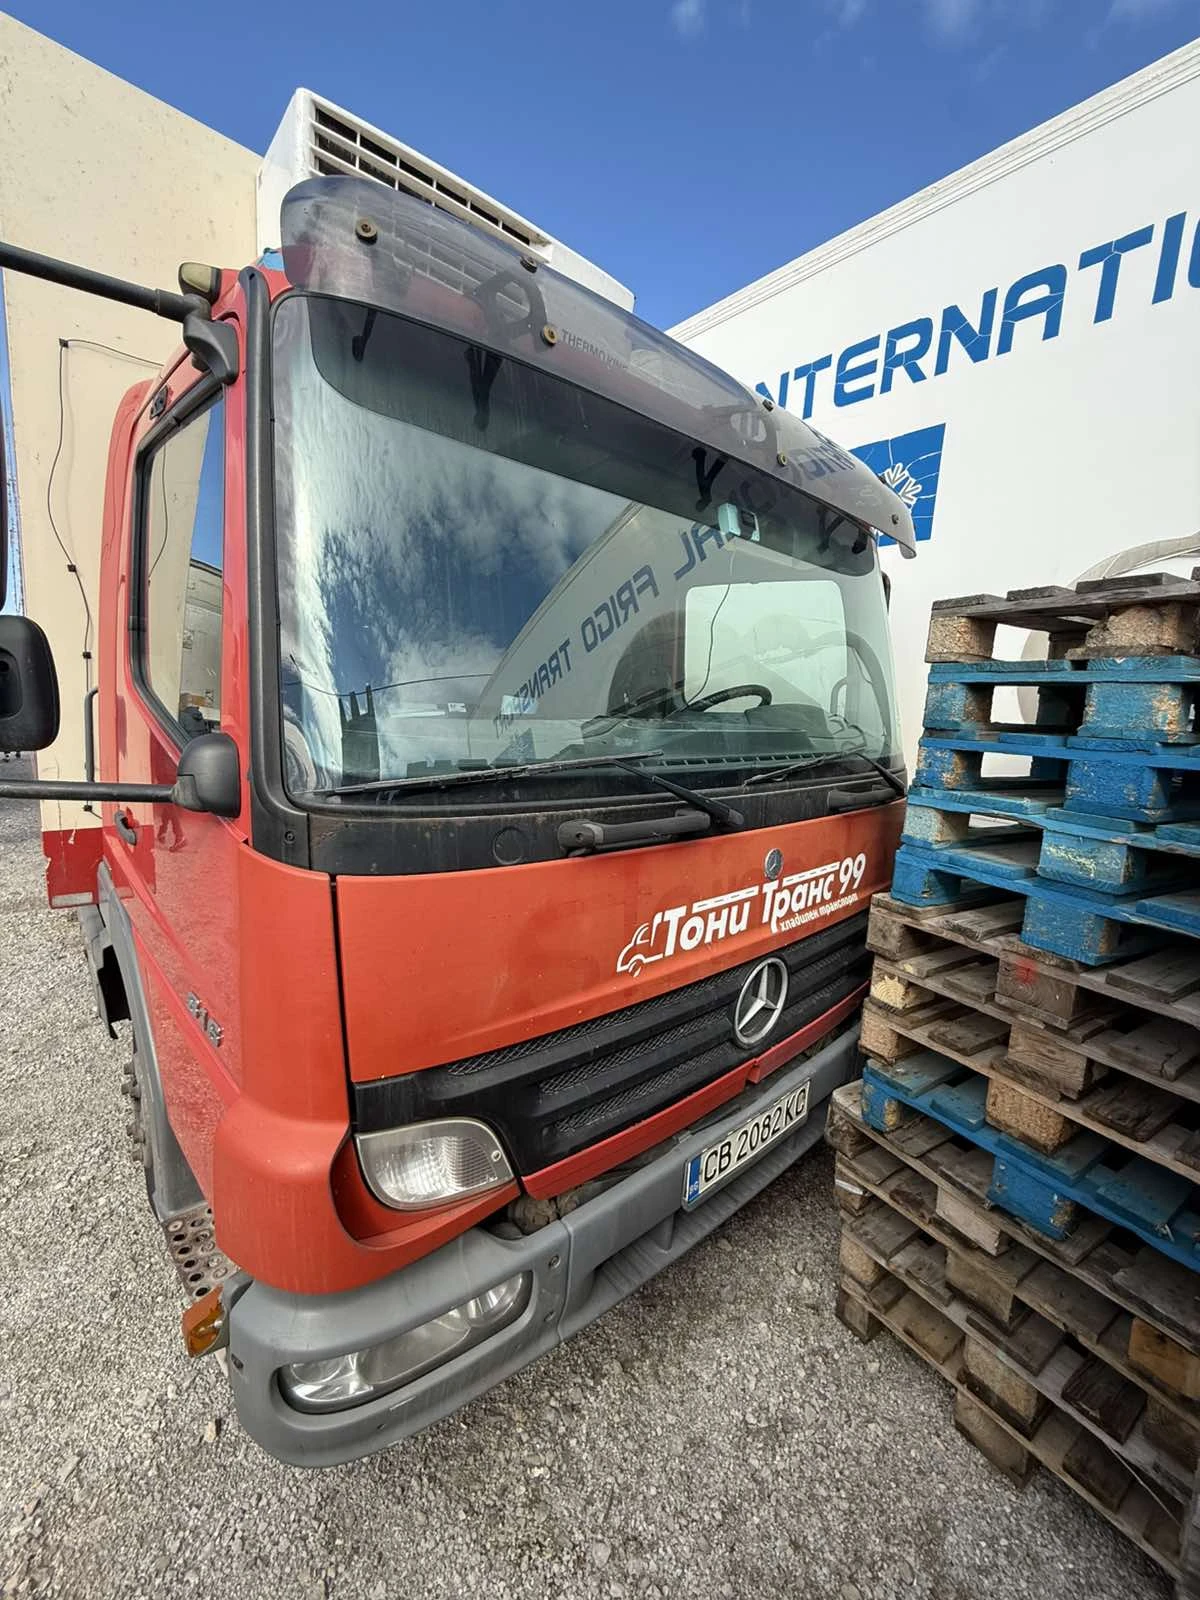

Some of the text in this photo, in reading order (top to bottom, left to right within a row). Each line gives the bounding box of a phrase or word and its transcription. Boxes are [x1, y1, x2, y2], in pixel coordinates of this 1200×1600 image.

[663, 852, 866, 957] Тони Транс 99
[736, 1107, 782, 1162] 2082
